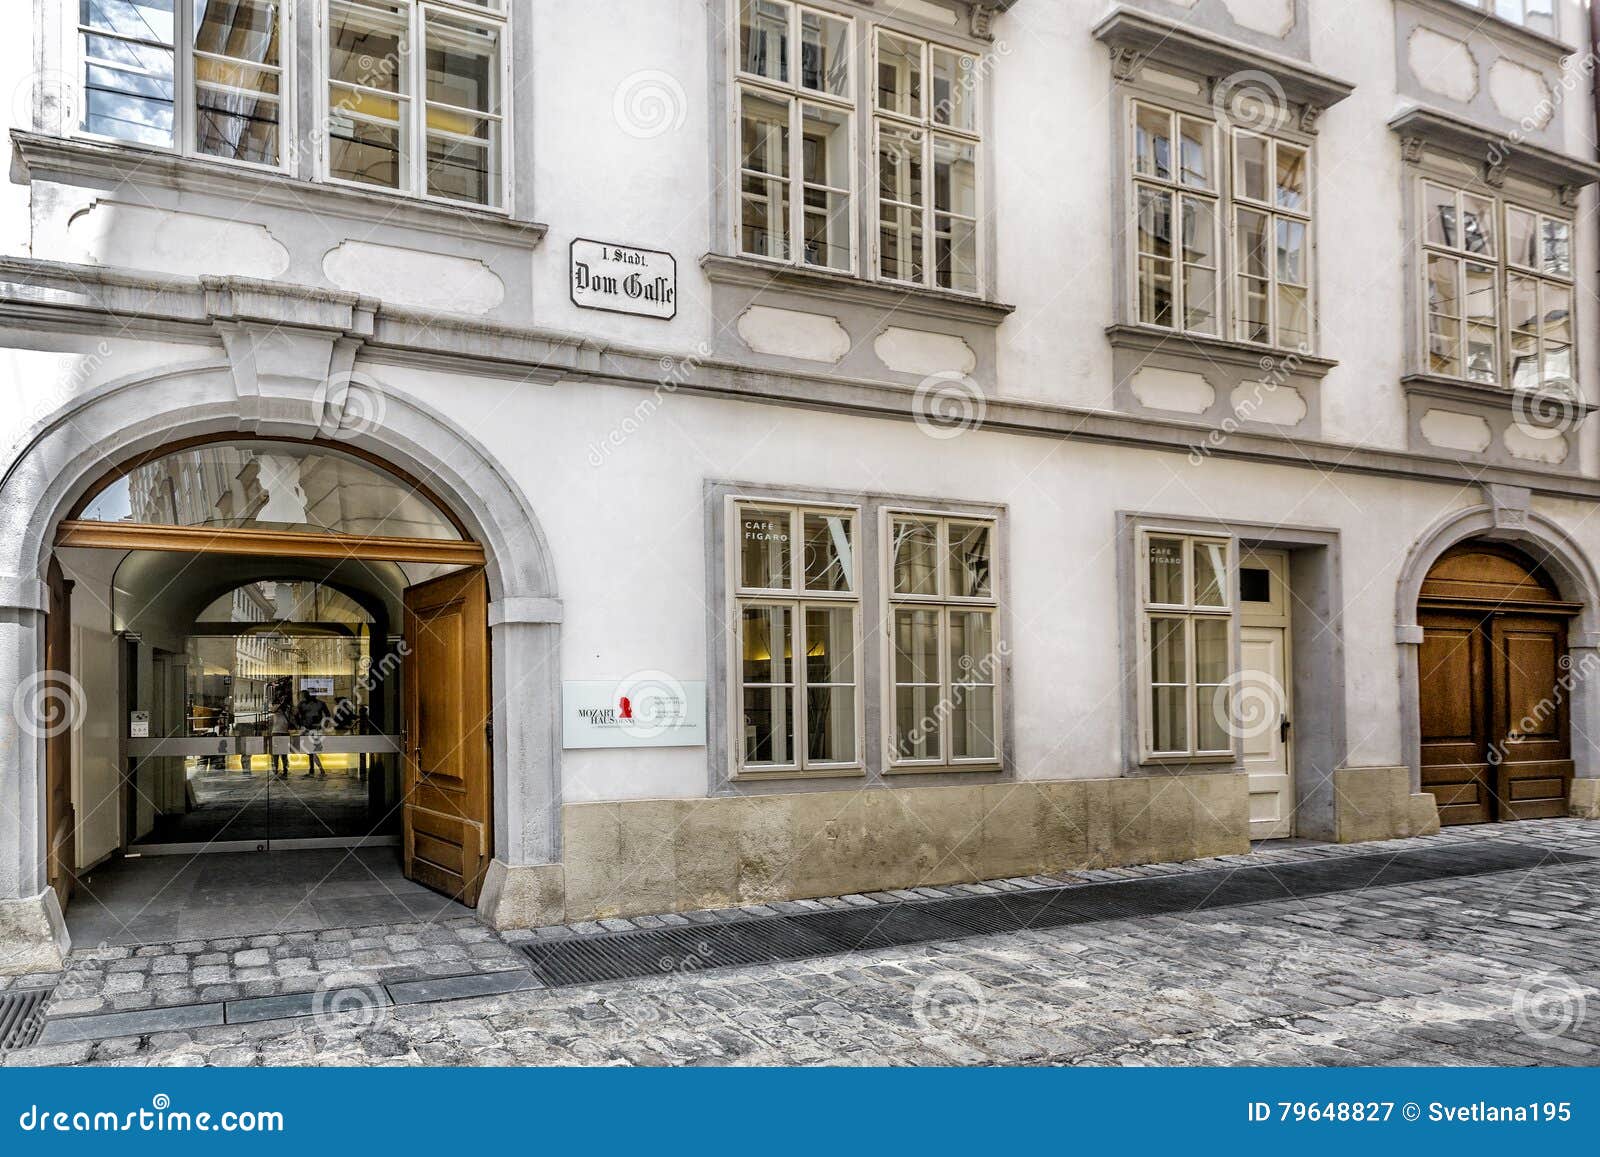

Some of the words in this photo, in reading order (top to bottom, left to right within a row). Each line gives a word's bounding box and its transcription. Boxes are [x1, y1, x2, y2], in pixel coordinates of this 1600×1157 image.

[575, 260, 619, 295] Dom
[745, 532, 788, 542] FIGARO
[578, 709, 615, 717] MOZART
